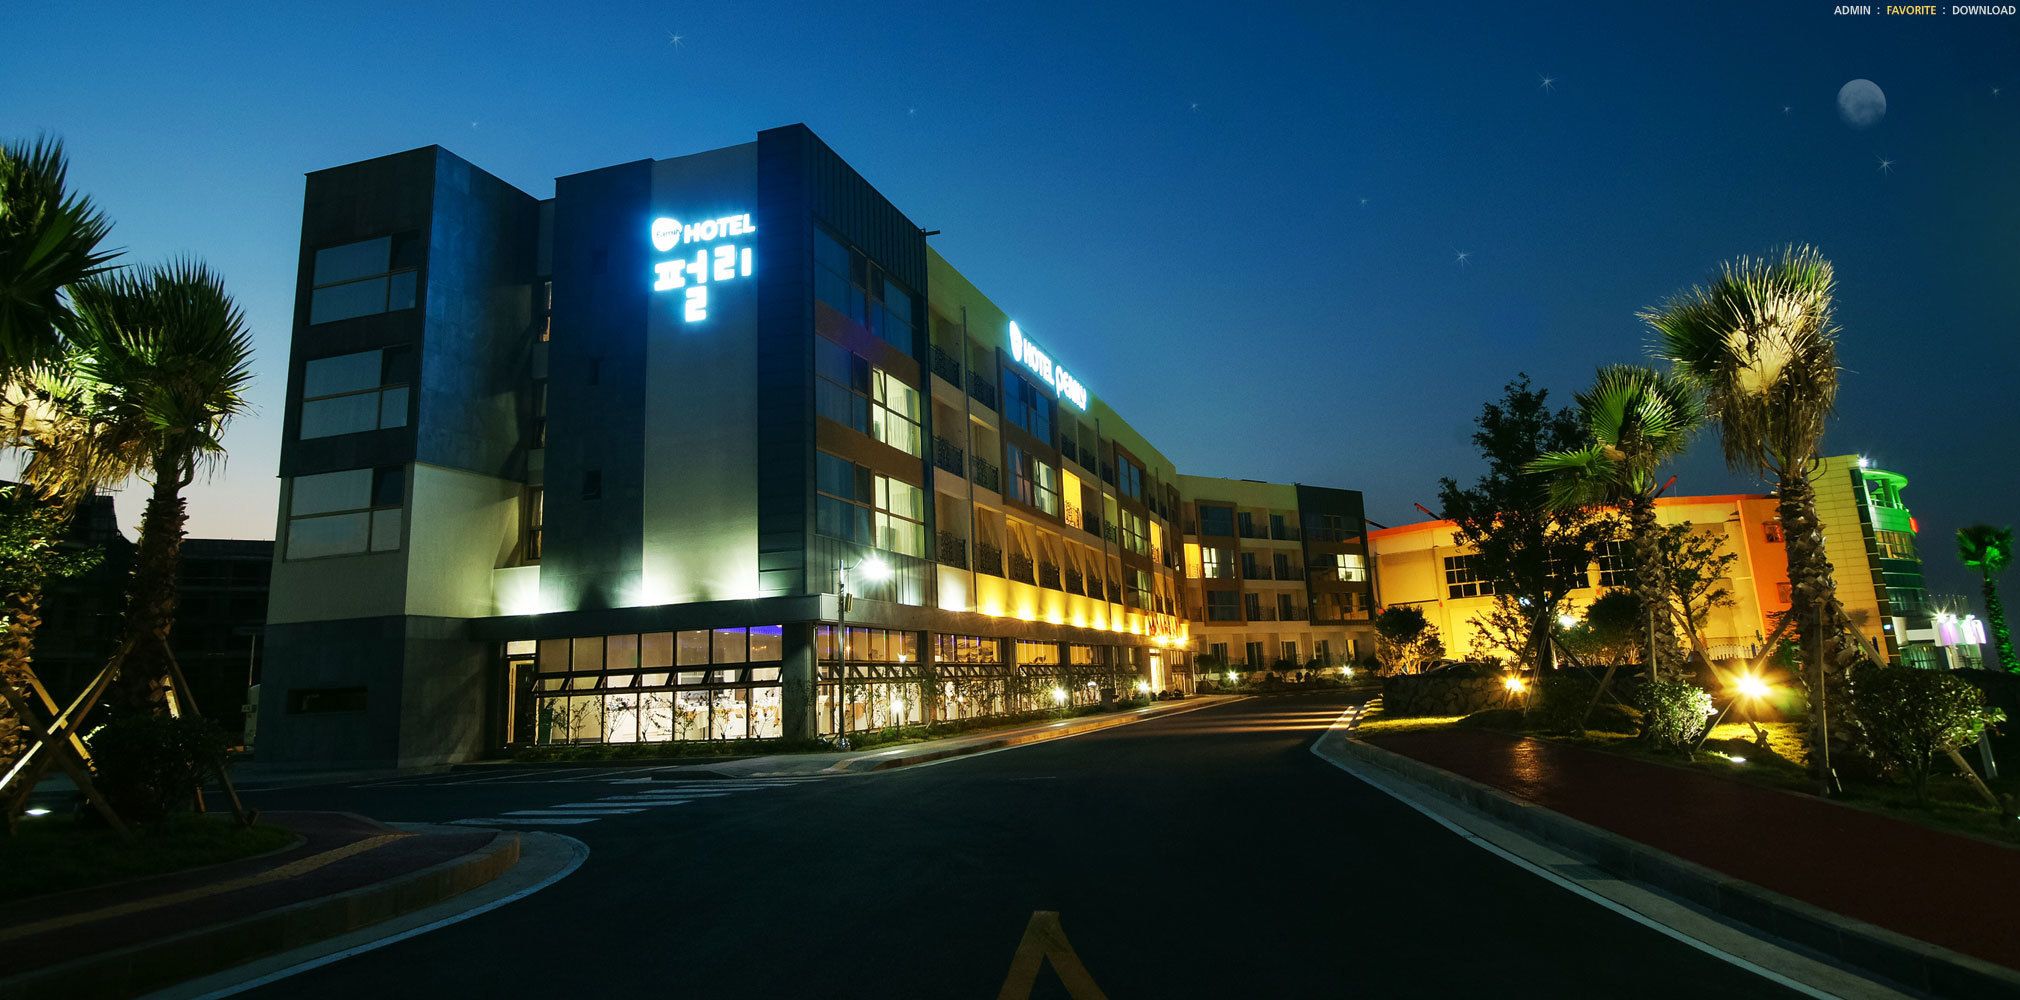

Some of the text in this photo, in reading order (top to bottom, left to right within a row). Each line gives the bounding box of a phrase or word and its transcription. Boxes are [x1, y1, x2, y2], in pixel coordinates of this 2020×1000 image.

[683, 213, 756, 244] HOTEL
[653, 244, 753, 323] 펄리
[1023, 338, 1055, 386] HOTEL
